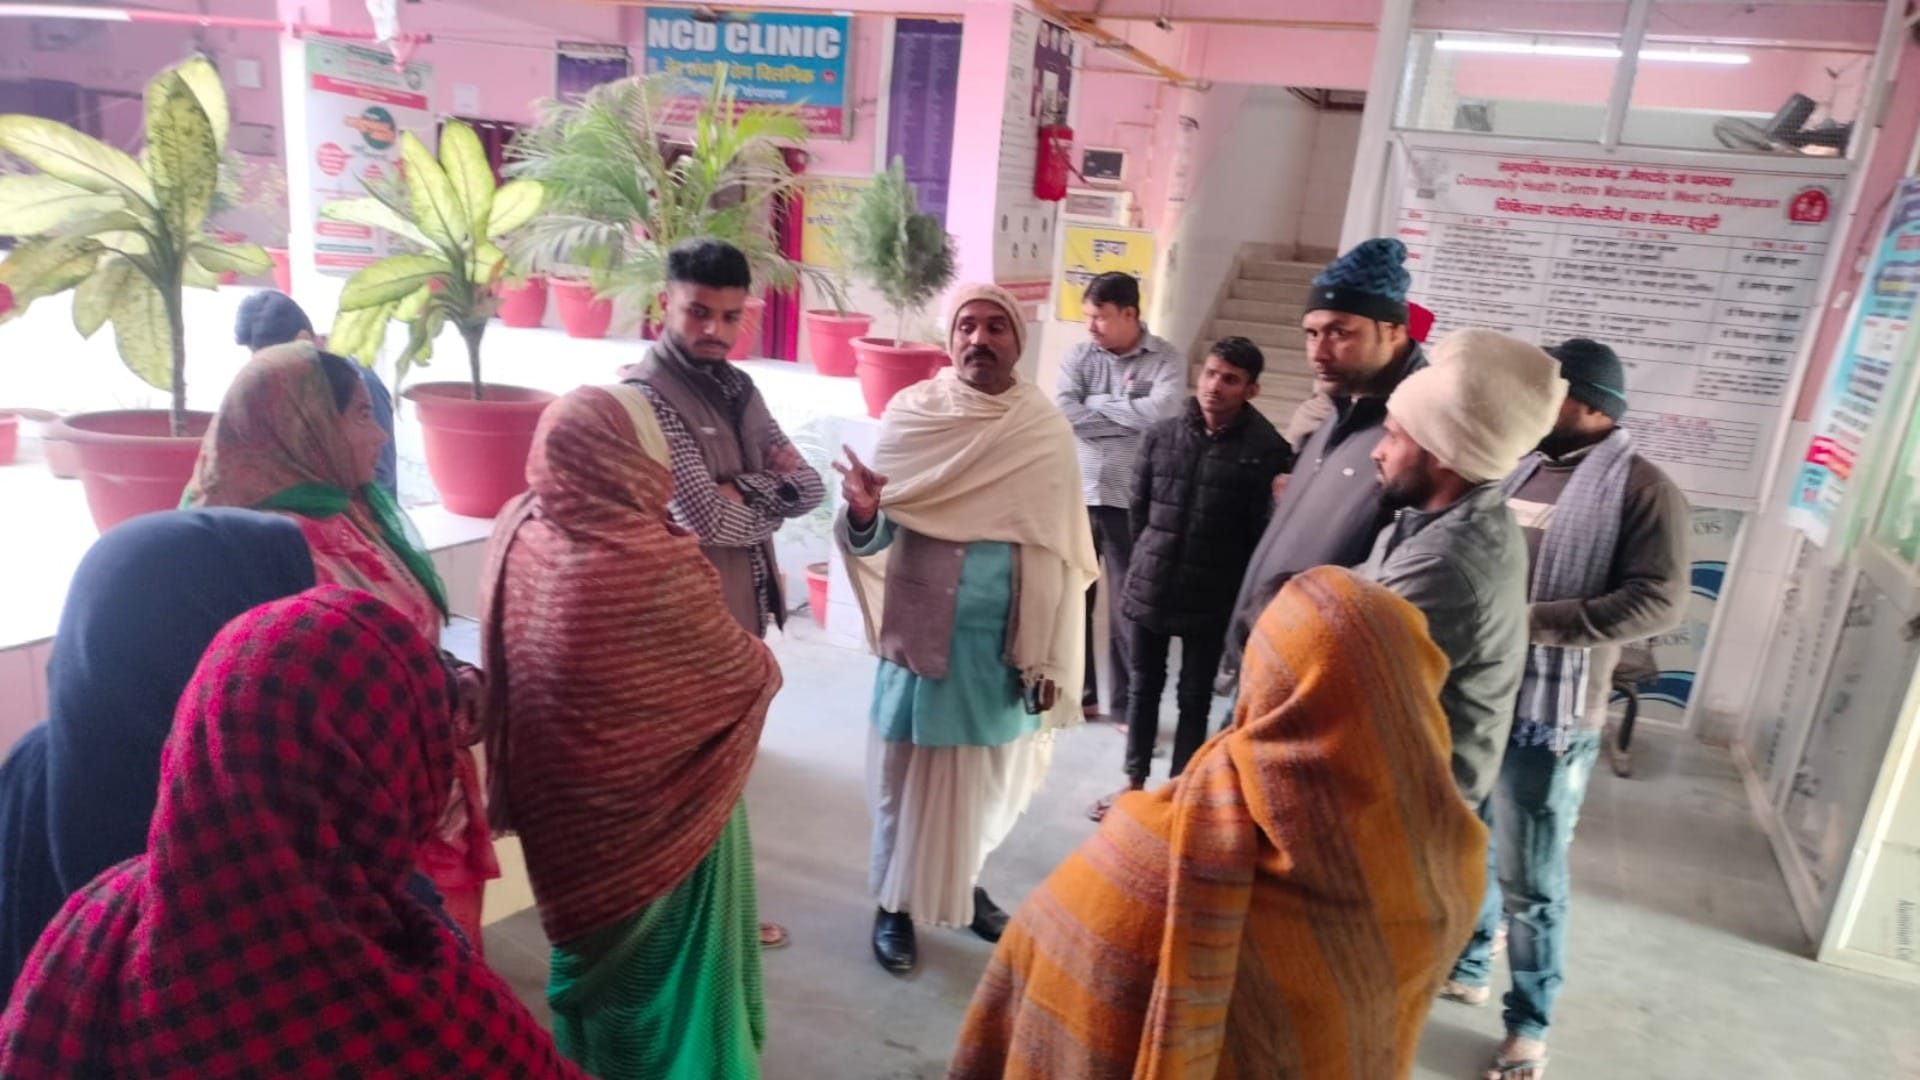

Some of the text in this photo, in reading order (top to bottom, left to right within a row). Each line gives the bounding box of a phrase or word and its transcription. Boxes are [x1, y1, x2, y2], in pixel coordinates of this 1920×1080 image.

[647, 17, 841, 60] NCD CLINIC
[1456, 174, 1518, 191] Community
[1521, 178, 1557, 192] Health
[1562, 182, 1599, 195] Centre
[1708, 193, 1780, 209] Champaran
